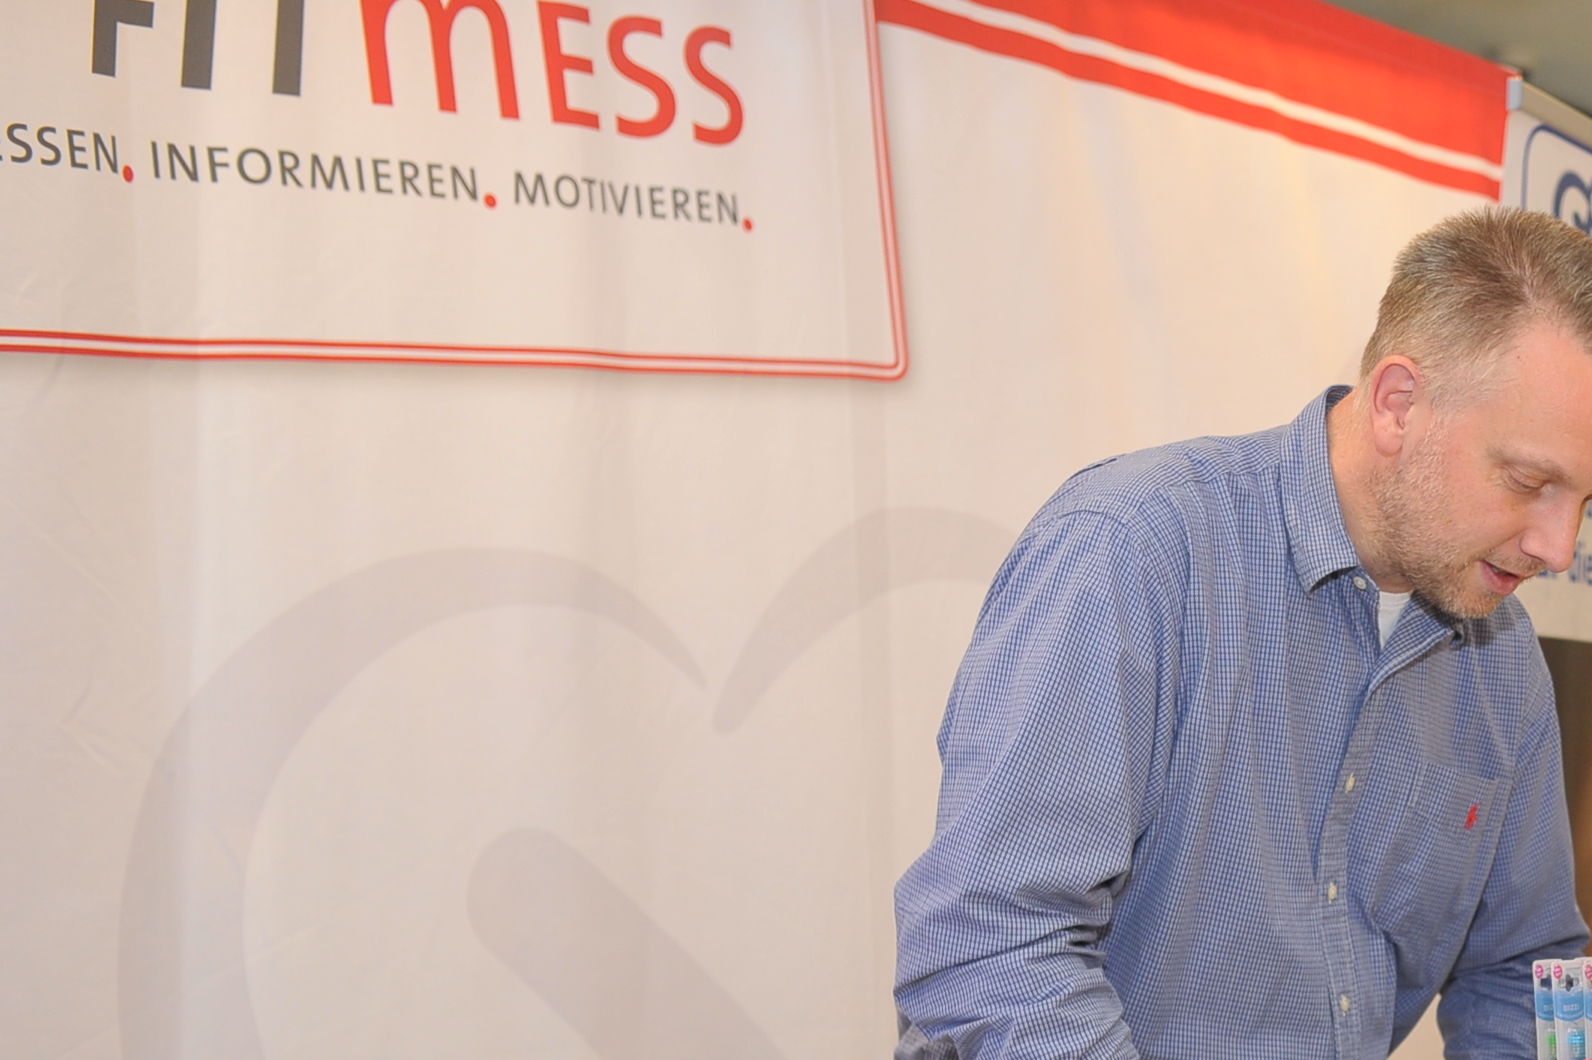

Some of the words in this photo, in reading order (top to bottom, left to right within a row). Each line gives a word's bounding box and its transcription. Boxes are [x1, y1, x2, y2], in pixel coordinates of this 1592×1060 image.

[0, 122, 134, 183] SSEN.
[150, 140, 498, 209] INFORMIEREN.
[513, 171, 754, 232] MOTIVIEREN.
